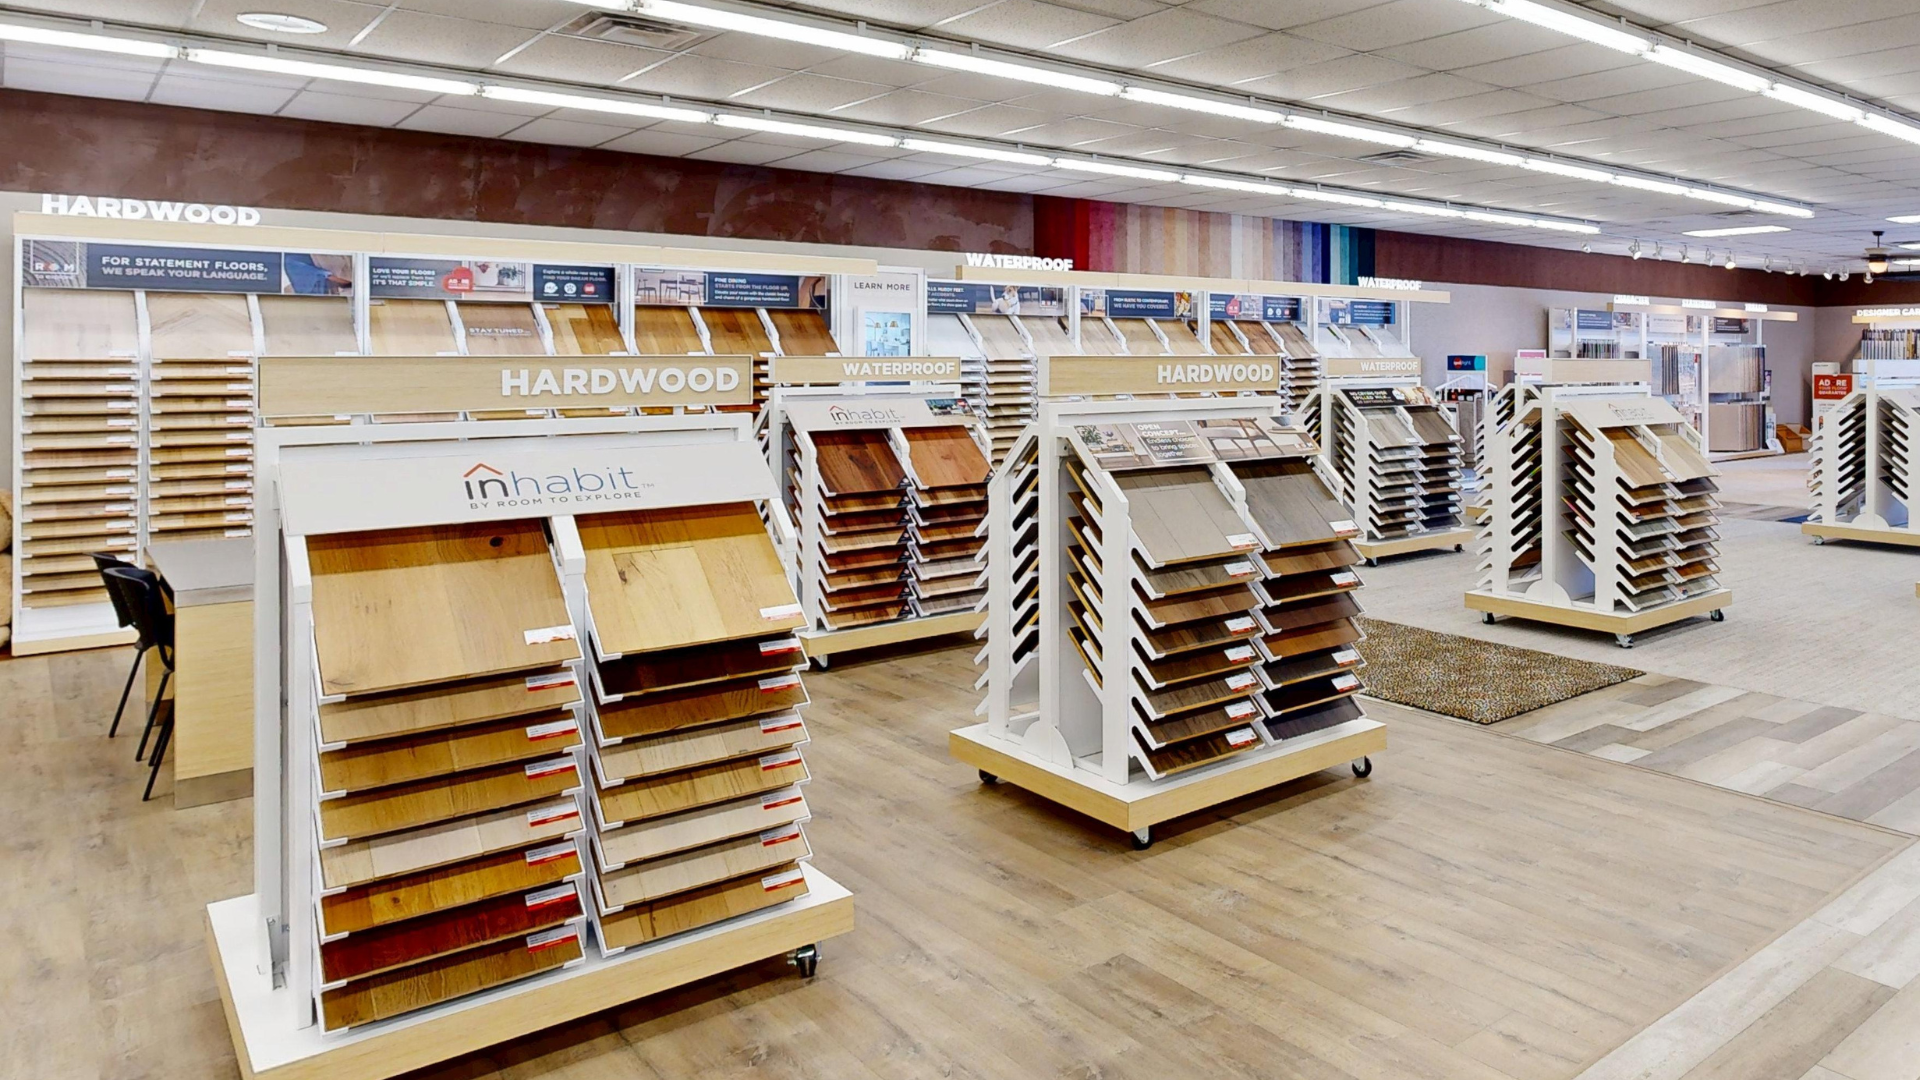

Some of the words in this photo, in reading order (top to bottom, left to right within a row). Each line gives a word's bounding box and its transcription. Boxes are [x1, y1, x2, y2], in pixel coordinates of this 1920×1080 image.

[42, 193, 261, 226] HARDWOOD
[102, 256, 130, 265] FOR
[135, 258, 210, 269] STATEMENT
[215, 261, 268, 272] FLOORS,
[965, 253, 1073, 271] WATERPROOF
[102, 267, 123, 275] WE
[125, 268, 165, 277] SPEAK
[168, 269, 200, 278] YOUR
[203, 271, 268, 281] LANGUAGE.
[886, 283, 910, 291] MORE
[1357, 276, 1422, 291] WATERPROOF
[1856, 308, 1901, 317] DESIGNER
[842, 362, 956, 376] WATERPROOF
[1157, 364, 1274, 383] HARDWOOD
[1360, 361, 1418, 371] WATERPROOF
[501, 367, 739, 396] HARDWOOD
[830, 407, 897, 422] inhabit
[1137, 423, 1160, 431] OPEN
[464, 465, 638, 500] inhabit
[470, 501, 489, 510] BY
[497, 498, 543, 508] ROOM
[549, 495, 569, 504] TO
[575, 491, 642, 502] EXPLORE
